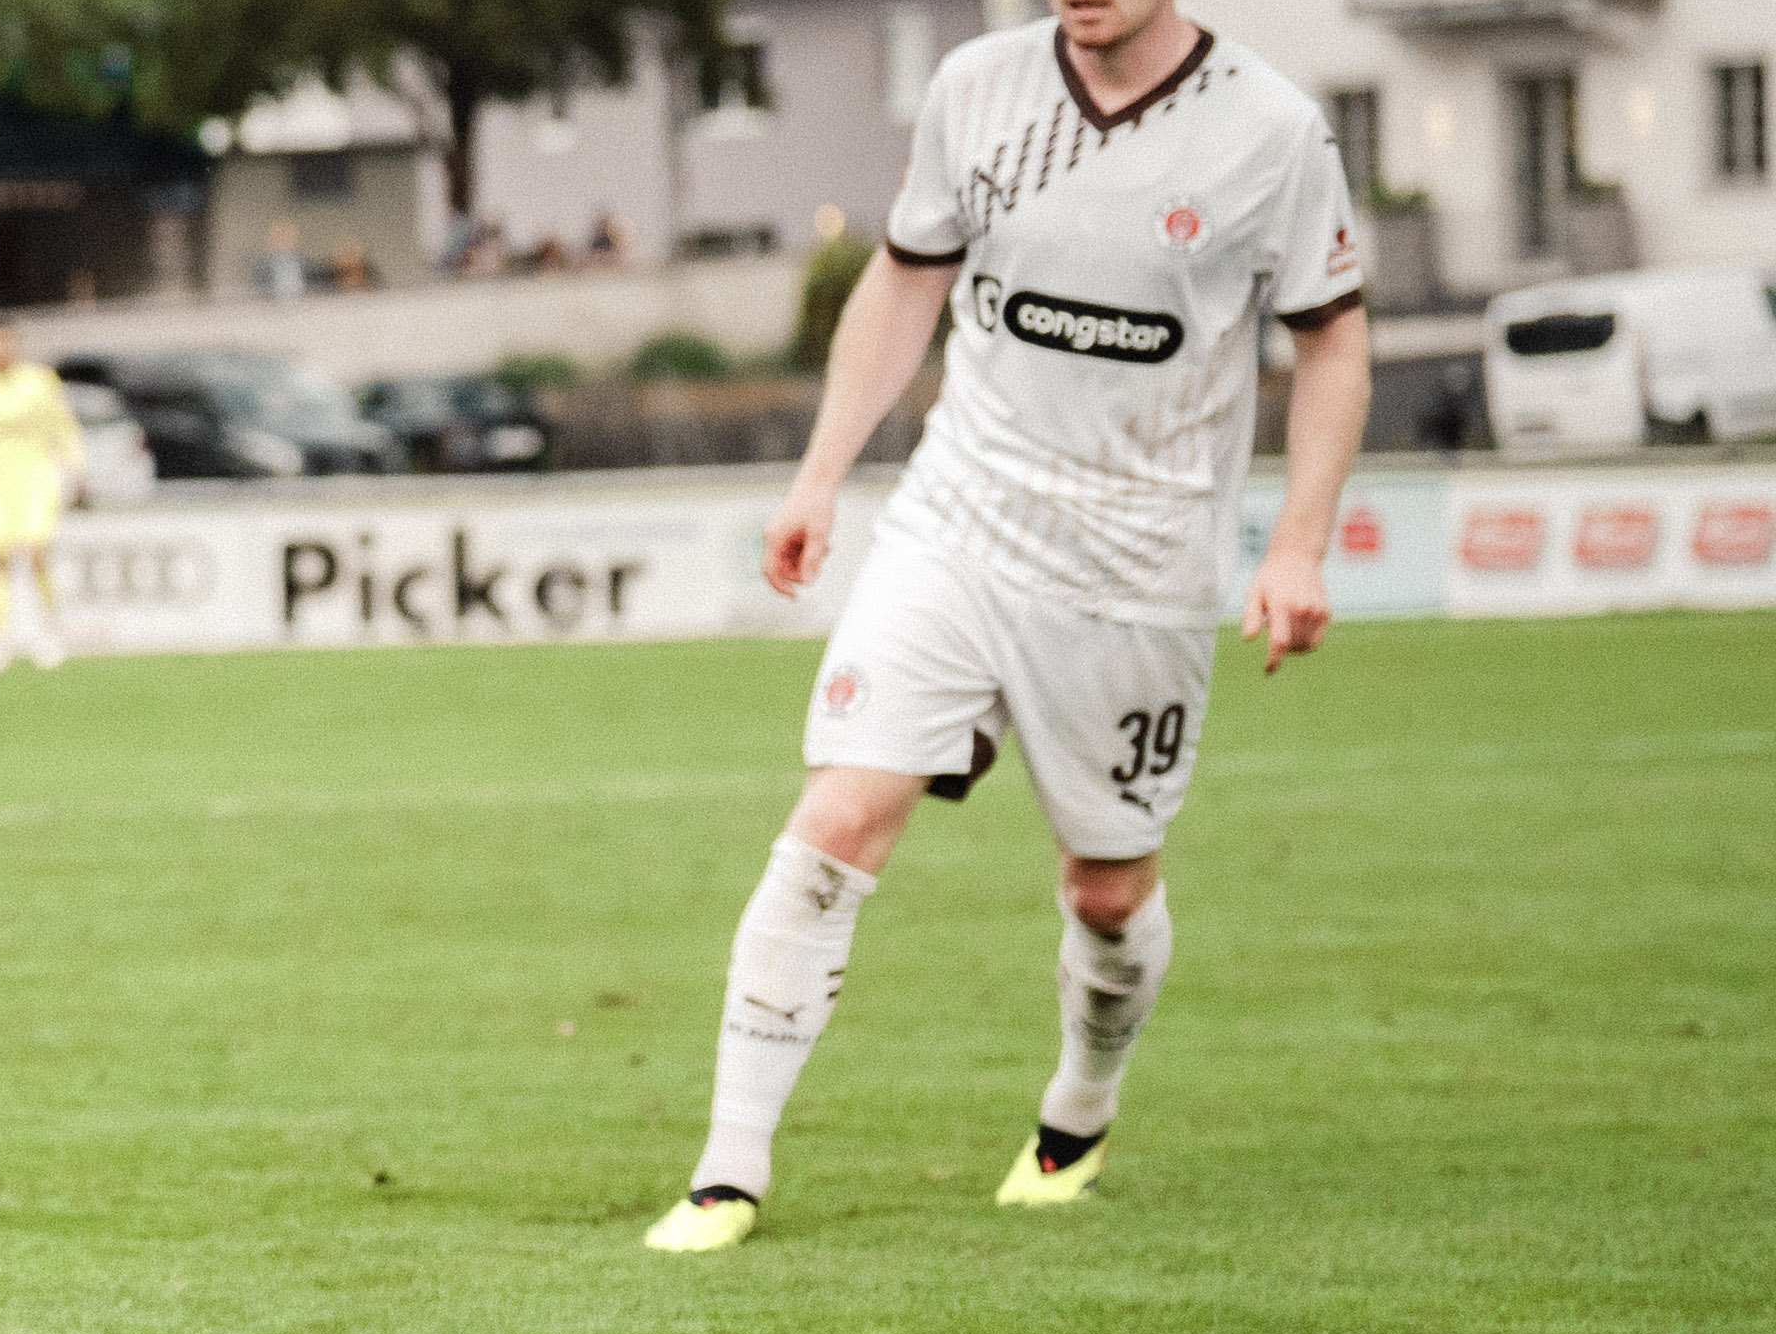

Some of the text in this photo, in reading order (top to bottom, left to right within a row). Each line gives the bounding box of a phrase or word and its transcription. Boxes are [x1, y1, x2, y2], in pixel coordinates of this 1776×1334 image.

[1016, 302, 1171, 351] congstar
[279, 527, 647, 629] Picker
[1111, 703, 1185, 783] 39
